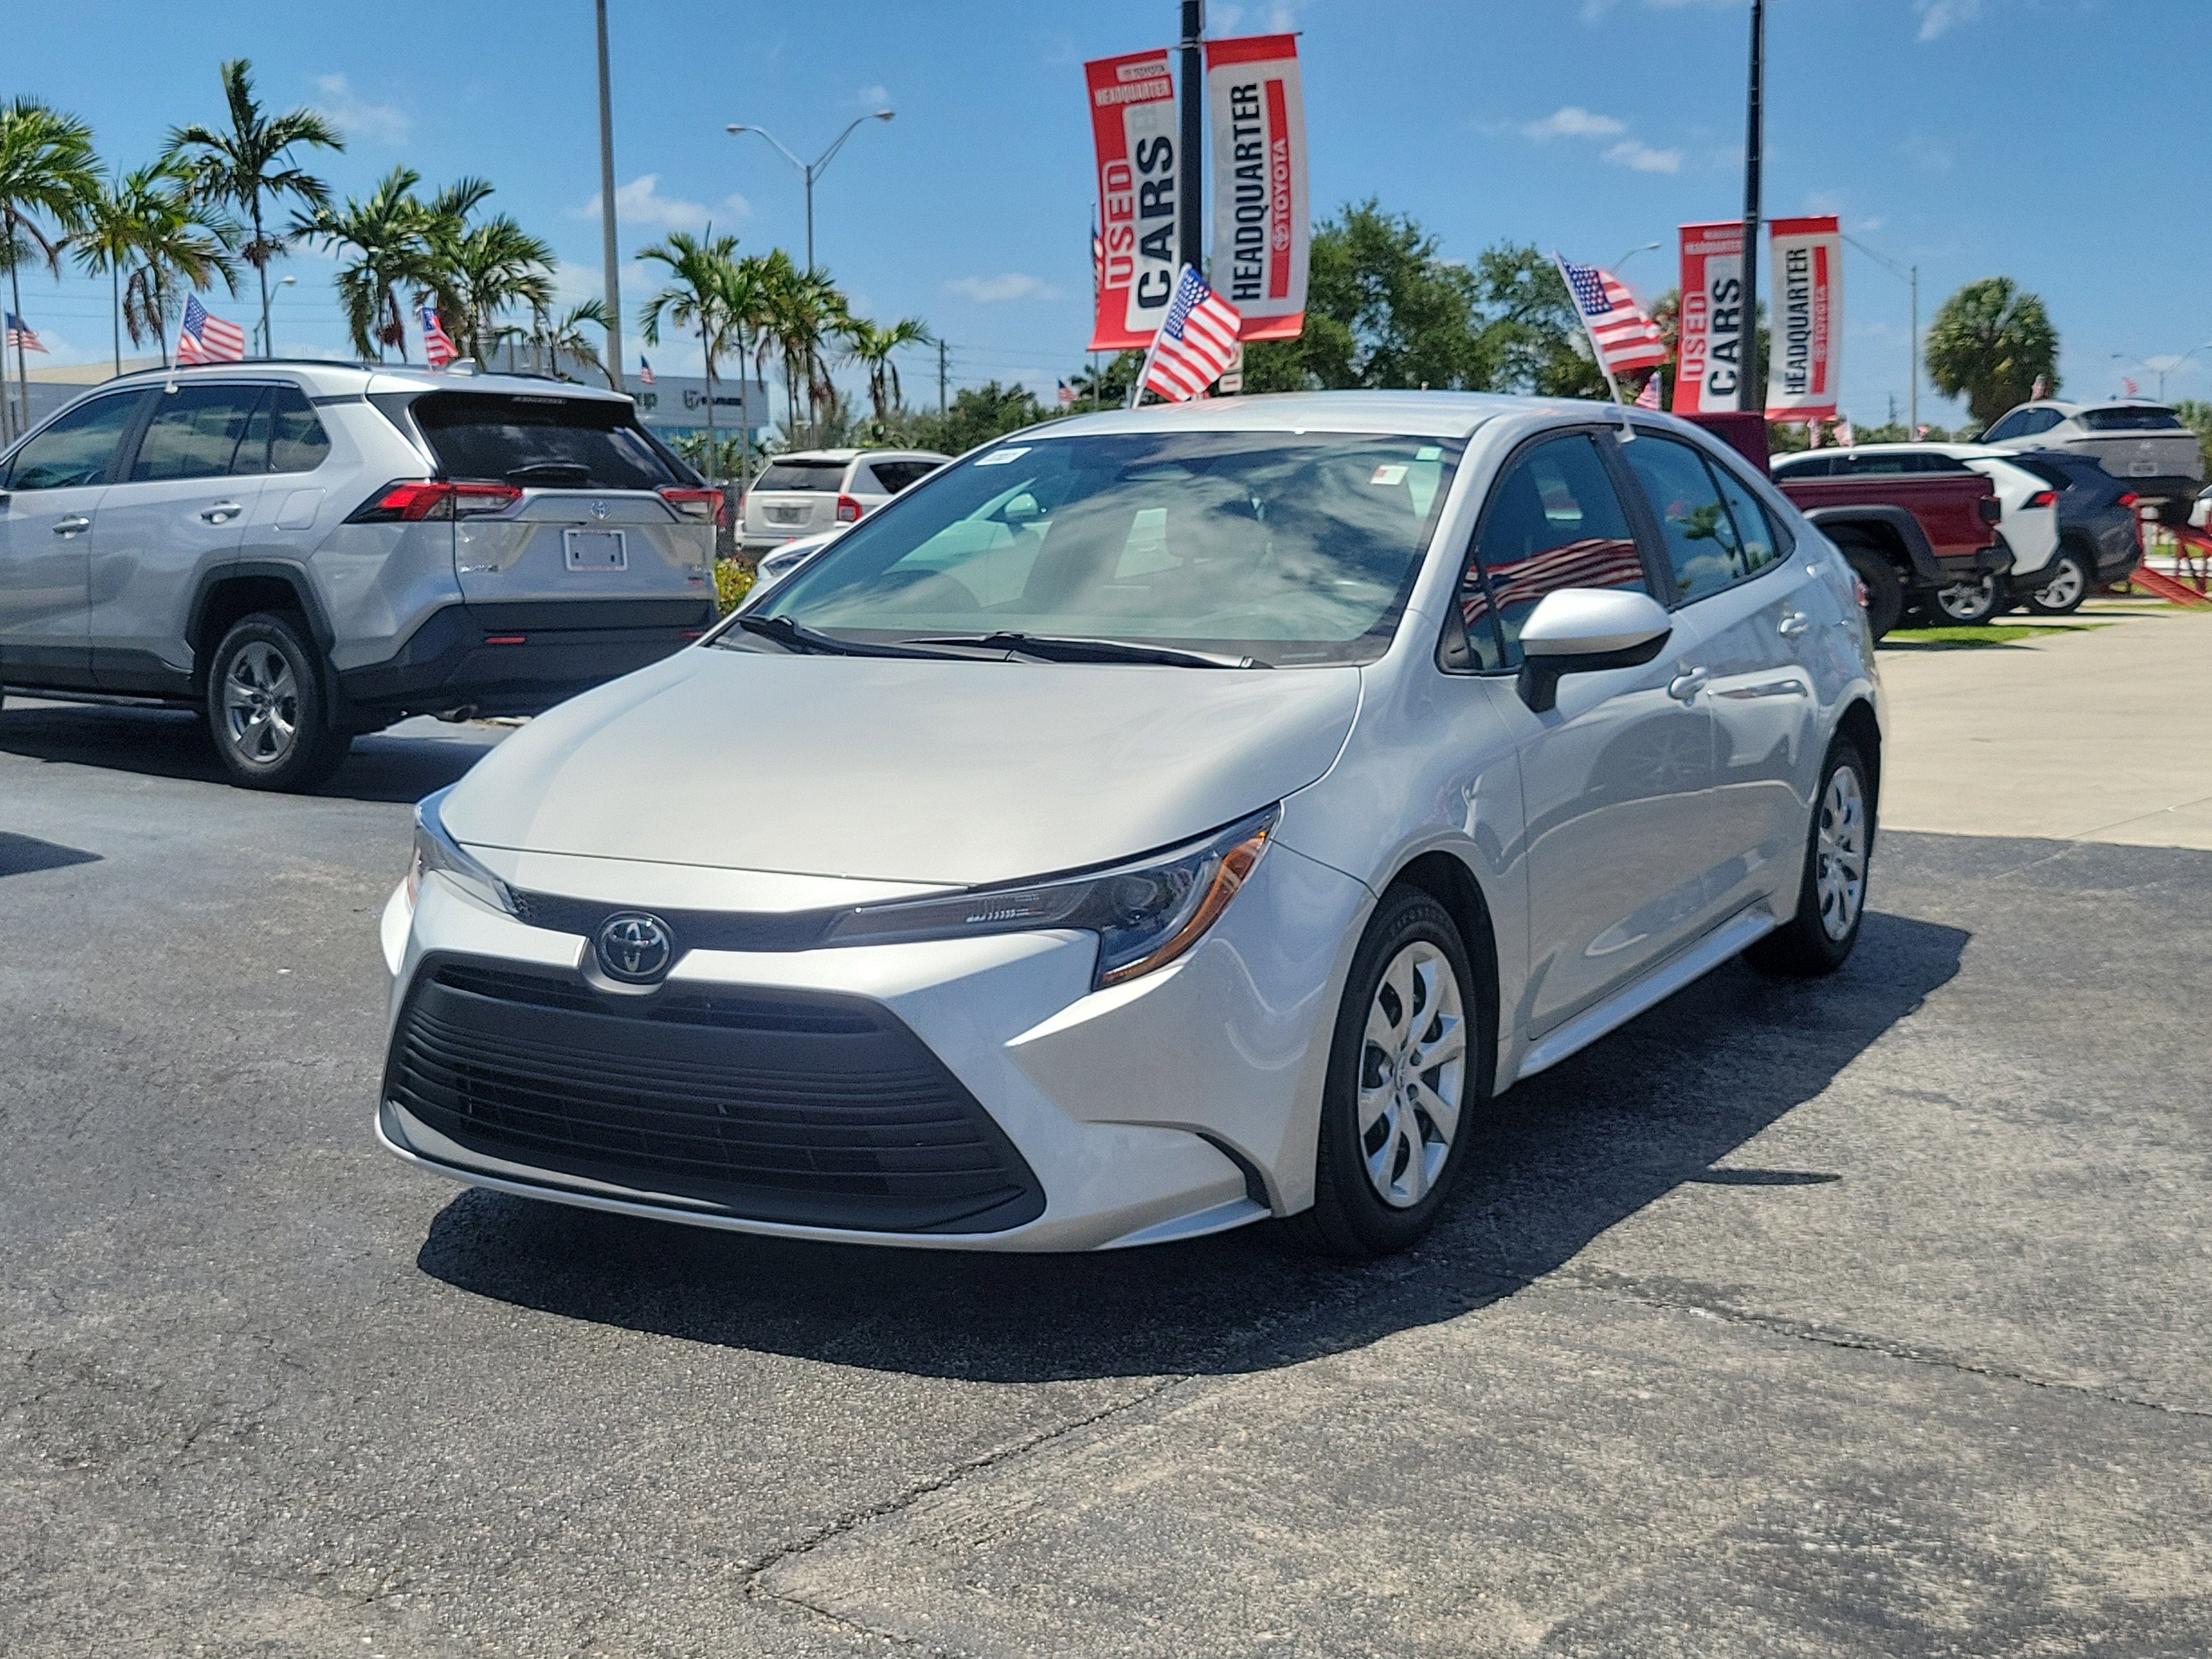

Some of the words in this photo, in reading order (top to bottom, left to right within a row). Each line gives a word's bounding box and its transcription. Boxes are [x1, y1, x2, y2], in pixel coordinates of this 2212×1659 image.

[1108, 165, 1134, 284] USED
[1137, 137, 1174, 308] CARS
[1232, 83, 1268, 300] HEADQUARTER
[1272, 139, 1289, 221] TOYOTA
[1684, 294, 1706, 376] USED
[1709, 278, 1741, 396] CARS
[1785, 248, 1812, 395] HEADQUARTER
